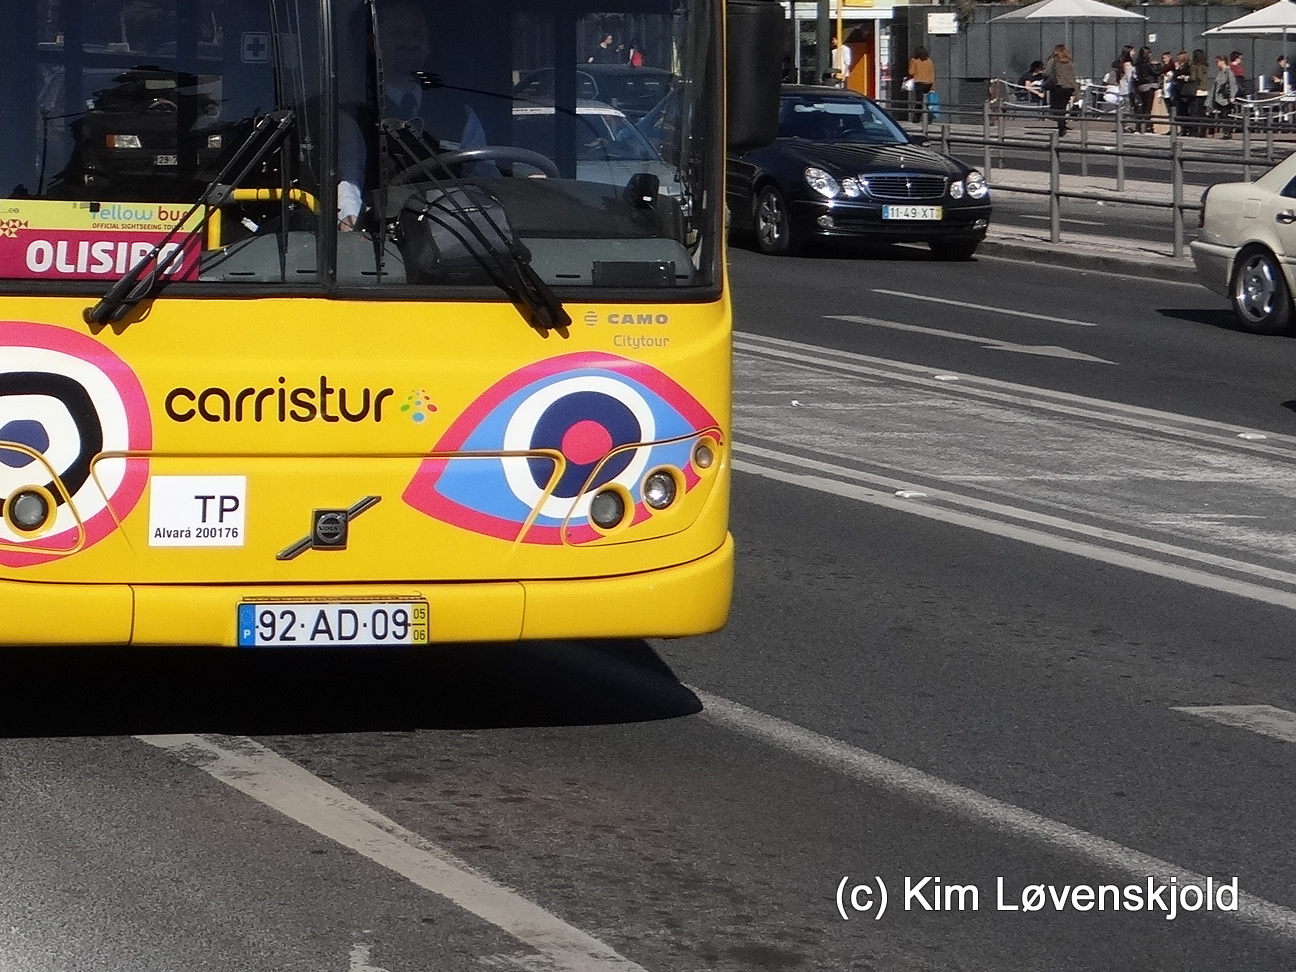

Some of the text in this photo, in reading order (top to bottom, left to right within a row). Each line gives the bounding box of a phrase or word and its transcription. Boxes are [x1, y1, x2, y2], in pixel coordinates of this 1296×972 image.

[92, 222, 120, 230] OFFICIAL
[121, 223, 162, 231] SIGHTSEEING
[607, 314, 668, 324] CAMO
[613, 334, 670, 349] Citytour
[165, 375, 394, 423] carristur
[194, 495, 240, 524] TP
[154, 526, 239, 538] Alvará 200176
[413, 608, 426, 620] 05
[413, 629, 426, 641] 06
